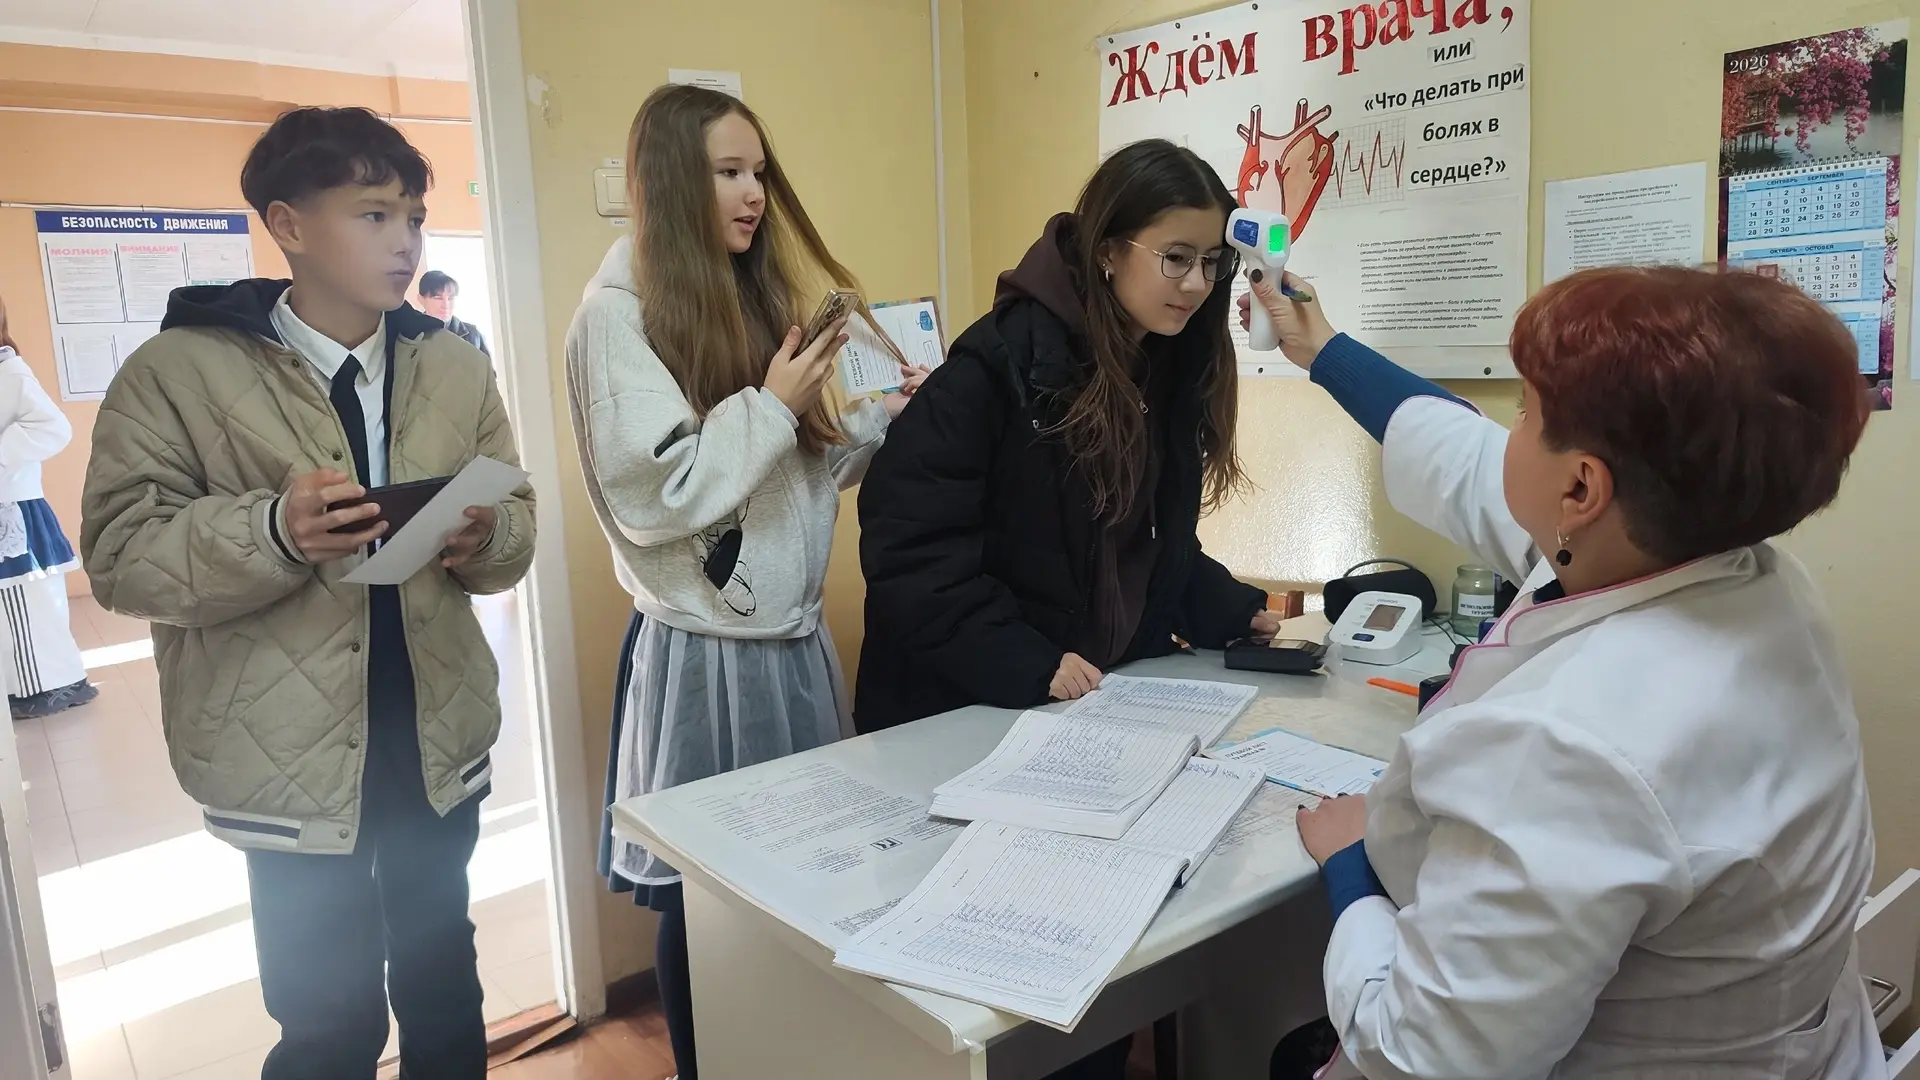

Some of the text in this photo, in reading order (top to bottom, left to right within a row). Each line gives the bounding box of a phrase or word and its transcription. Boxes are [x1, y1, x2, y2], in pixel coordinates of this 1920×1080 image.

[1107, 0, 1514, 108] Ждём врача,
[1433, 41, 1472, 63] или
[1729, 54, 1769, 75] 2026
[1364, 67, 1525, 113] «Что делать при
[1423, 119, 1499, 144] болях в
[1410, 158, 1507, 188] сердце?»
[1807, 172, 1844, 181] SEPTEMBER
[61, 216, 229, 232] БЕЗОПАСНОСТЬ ДВИЖЕНИЯ
[1804, 244, 1834, 252] OCTOBER
